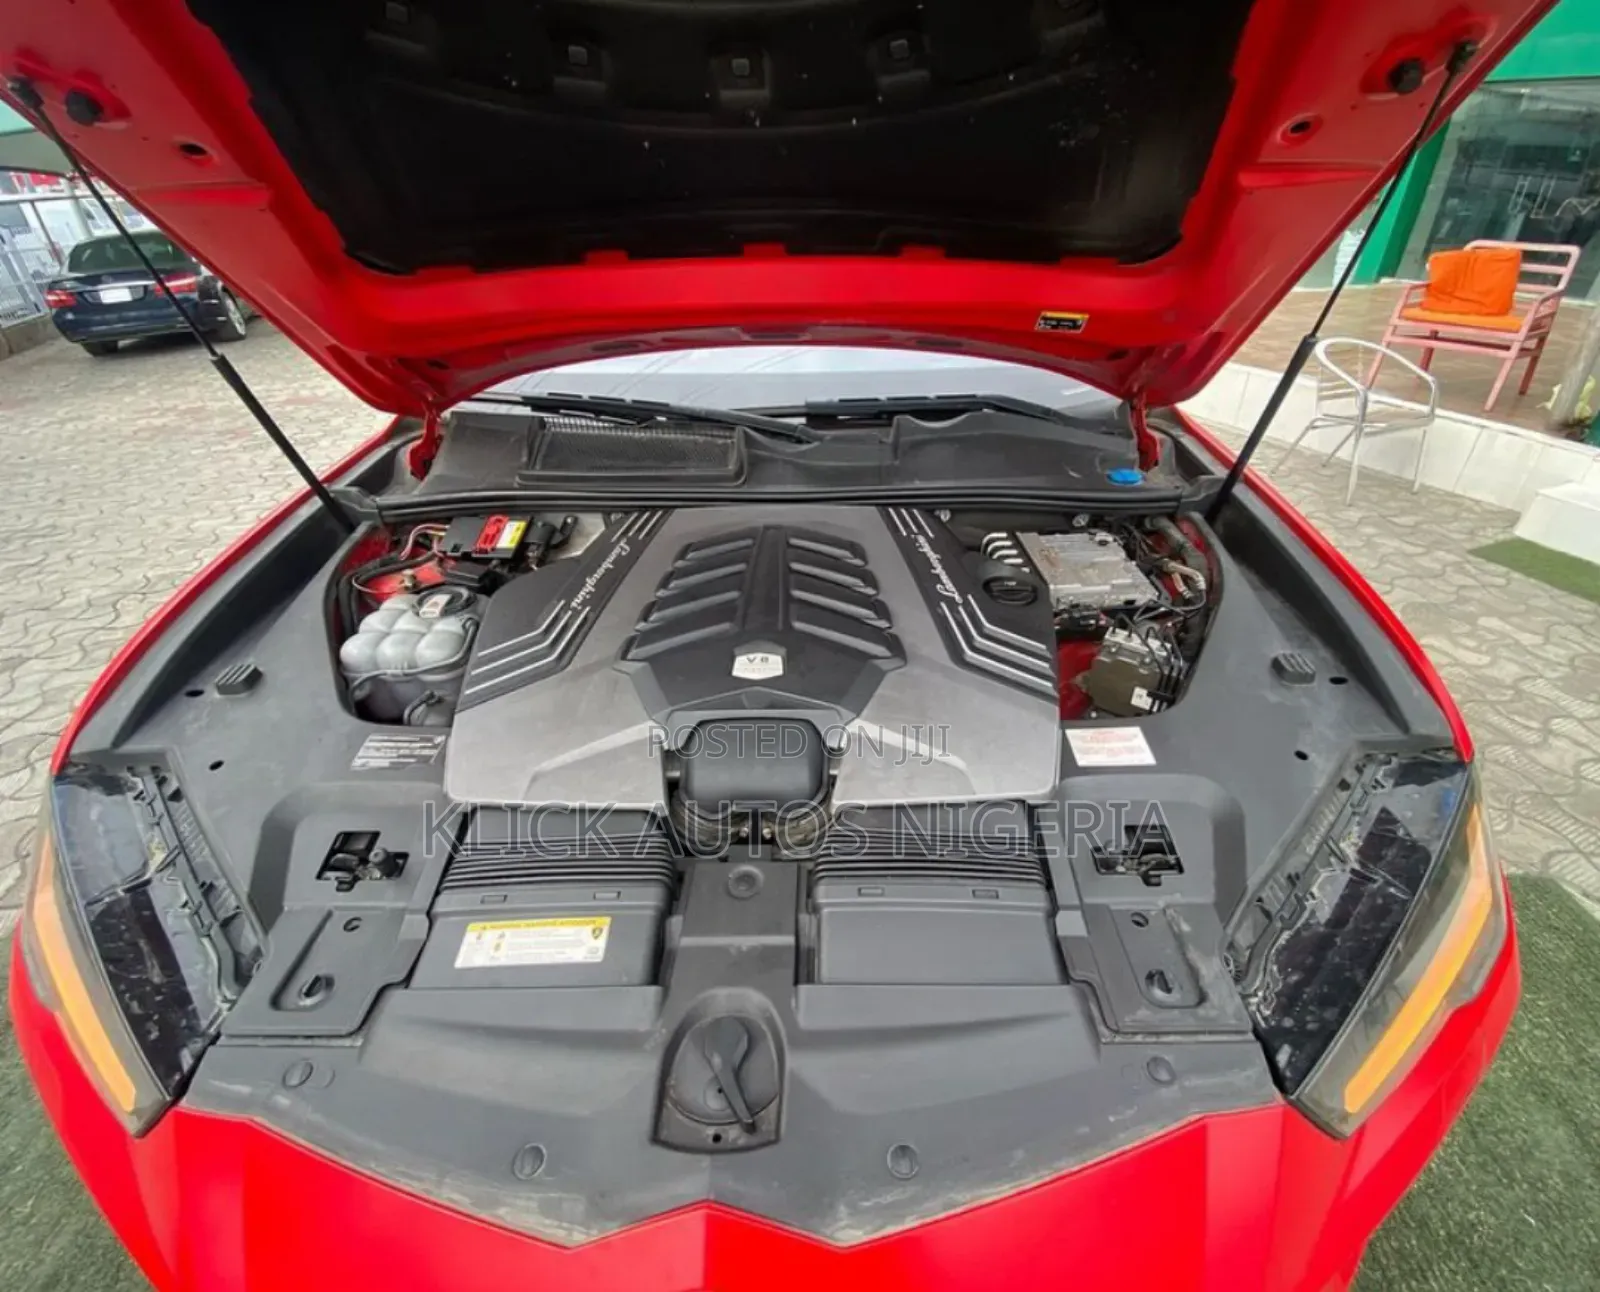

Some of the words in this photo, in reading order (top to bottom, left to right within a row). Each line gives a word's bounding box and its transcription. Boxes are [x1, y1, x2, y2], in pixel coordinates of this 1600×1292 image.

[570, 538, 630, 609] Lamborghini
[911, 534, 963, 604] Lamborghini
[746, 655, 769, 664] V8
